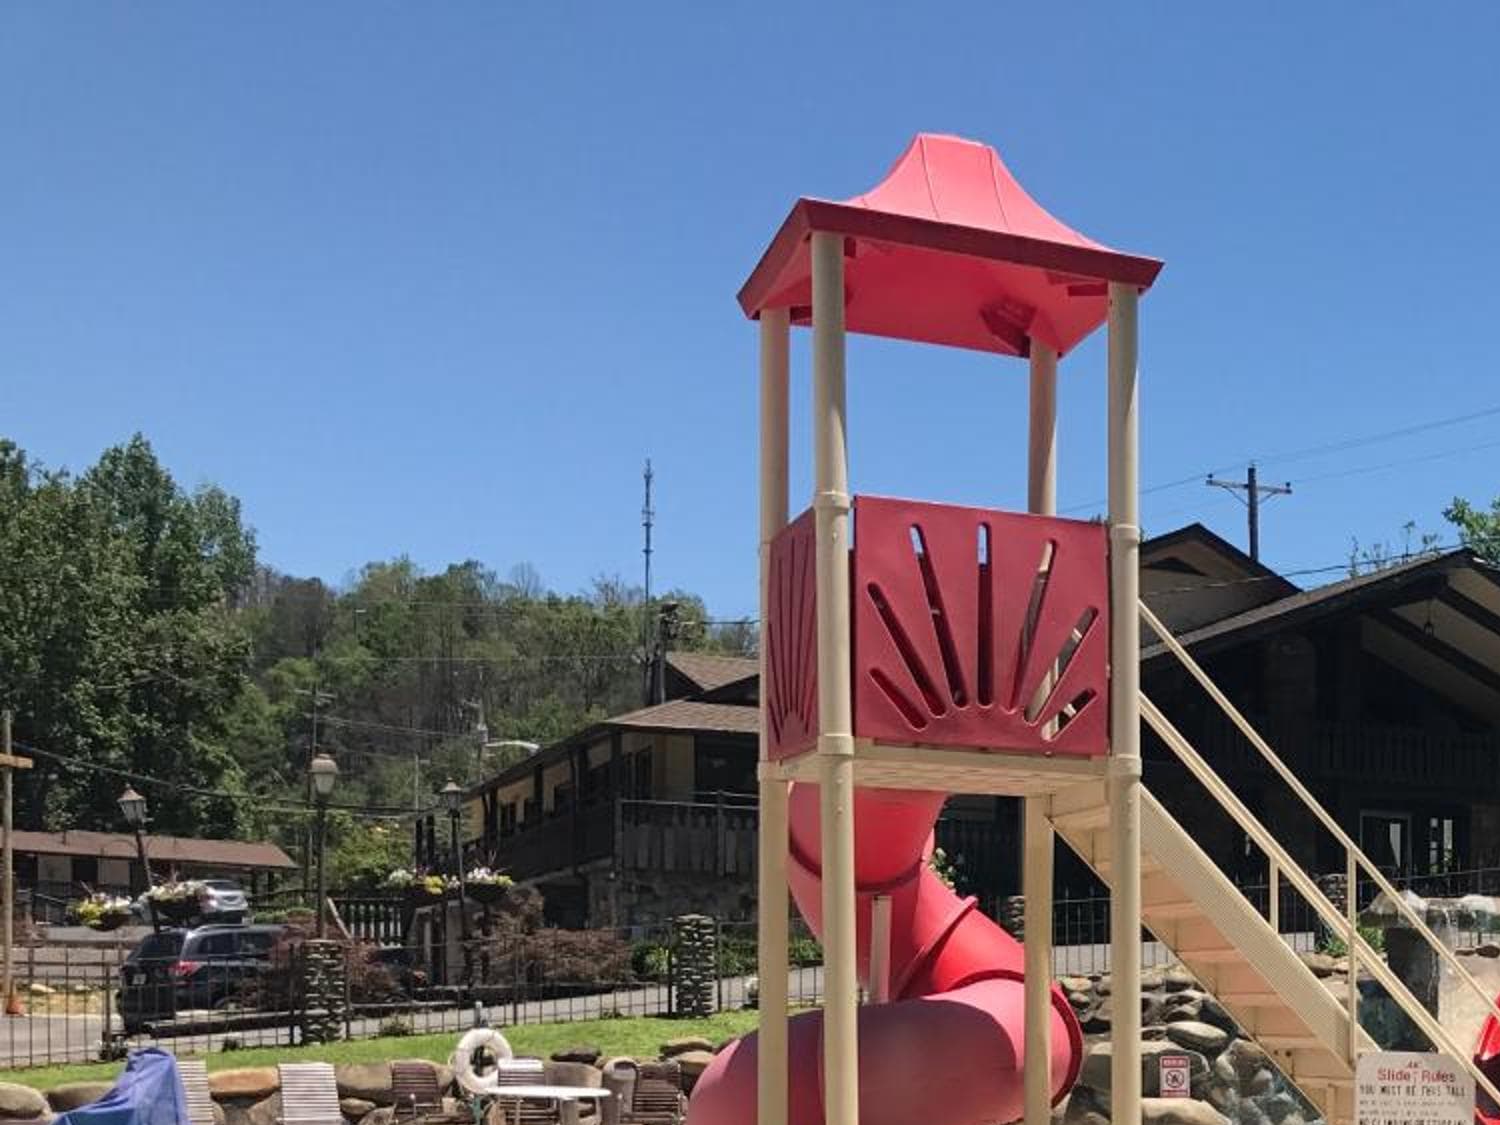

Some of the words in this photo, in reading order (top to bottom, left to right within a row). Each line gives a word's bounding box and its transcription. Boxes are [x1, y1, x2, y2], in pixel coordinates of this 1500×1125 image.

[1377, 1067, 1411, 1082] Slide
[1422, 1069, 1457, 1083] Rules
[1380, 1085, 1402, 1097] MUST
